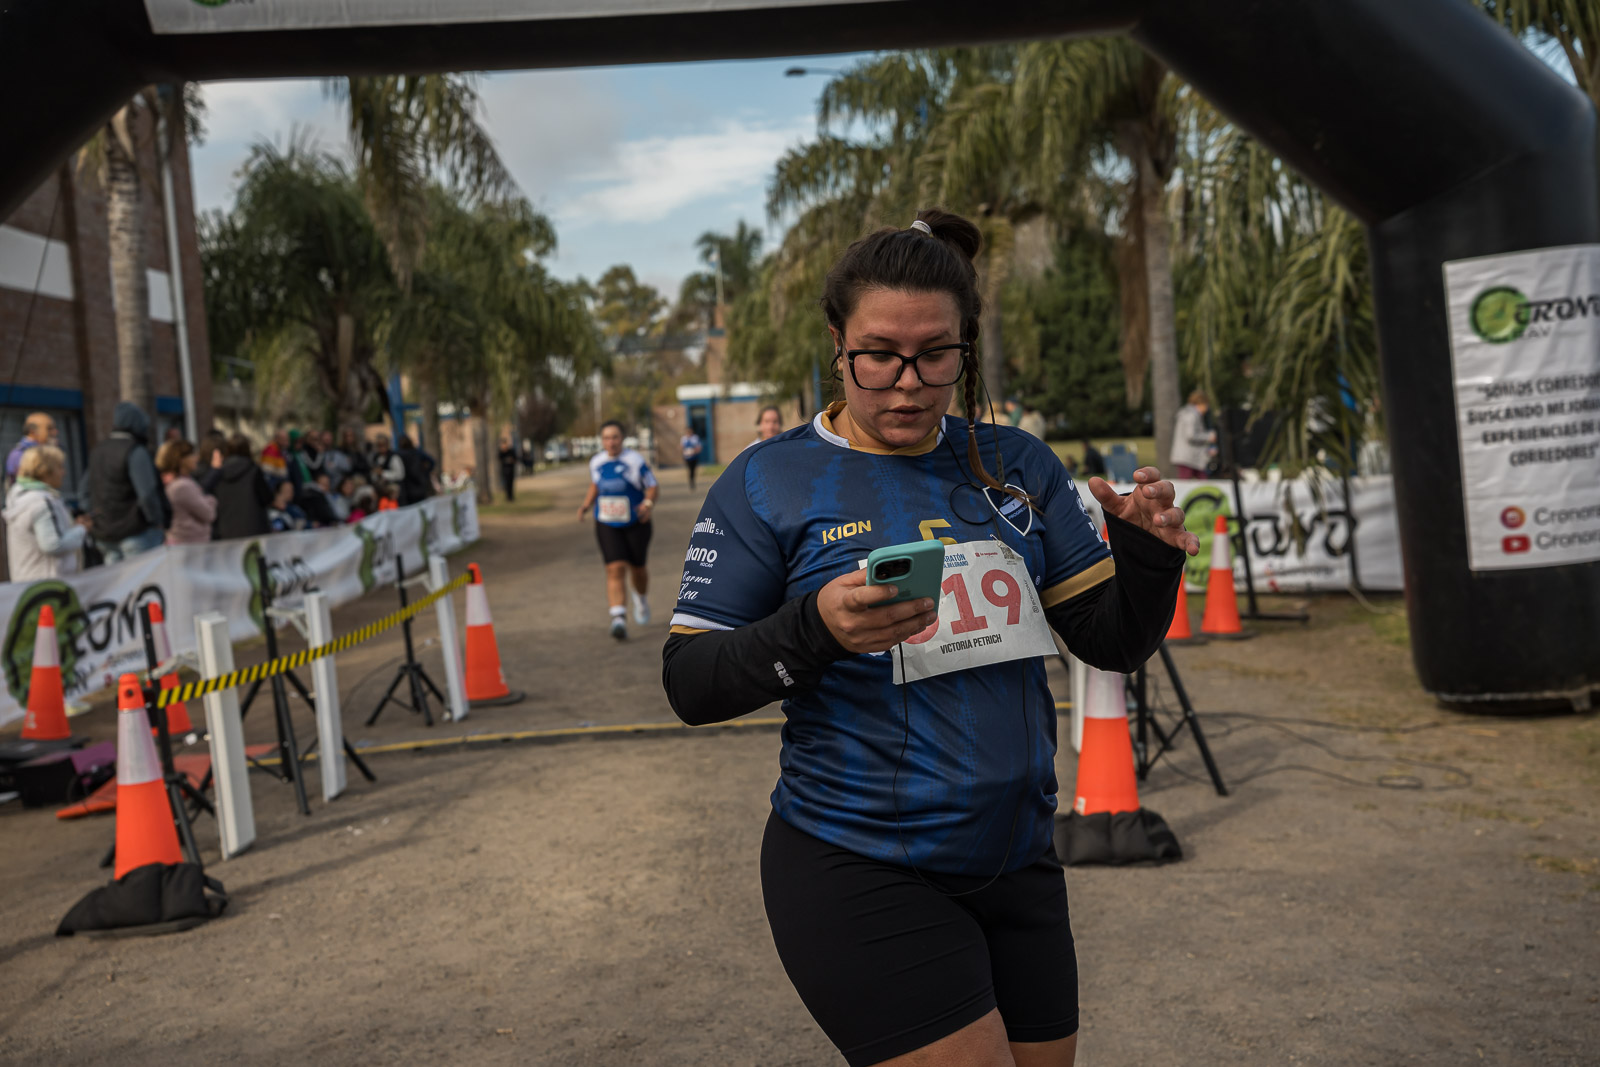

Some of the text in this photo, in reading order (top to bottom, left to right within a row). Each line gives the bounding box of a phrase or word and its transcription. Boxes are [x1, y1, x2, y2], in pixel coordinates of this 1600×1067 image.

[1467, 404, 1543, 424] BUSCANDO
[1482, 424, 1577, 445] EXPERIENCIAS
[822, 520, 873, 545] KION
[903, 569, 1021, 645] 19
[940, 633, 1003, 655] VICTORIA PETRICH
